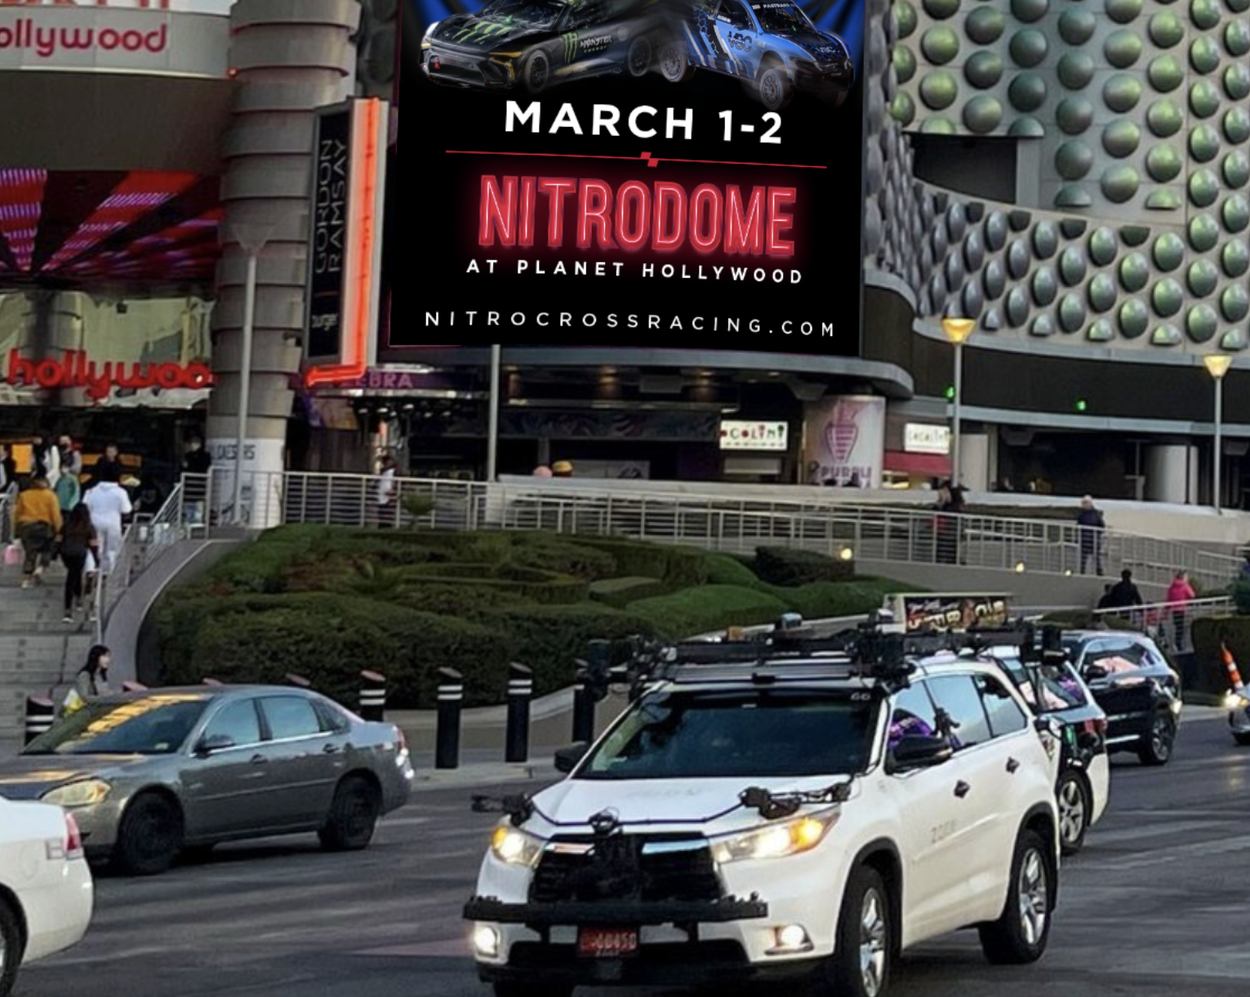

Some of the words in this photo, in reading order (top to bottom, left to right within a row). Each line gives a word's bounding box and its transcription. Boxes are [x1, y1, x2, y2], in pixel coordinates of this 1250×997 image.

[504, 99, 694, 140] MARCH
[719, 109, 783, 144] 1-2
[315, 139, 333, 274] GORDON
[328, 138, 347, 273] RAMSAY
[478, 174, 797, 257] NITRODOME
[466, 259, 498, 274] AT
[517, 259, 625, 277] PLANET
[642, 264, 802, 284] HOLLYWOOD
[425, 310, 834, 337] NITROCROSSRACING.COM
[9, 348, 215, 400] hollywoo
